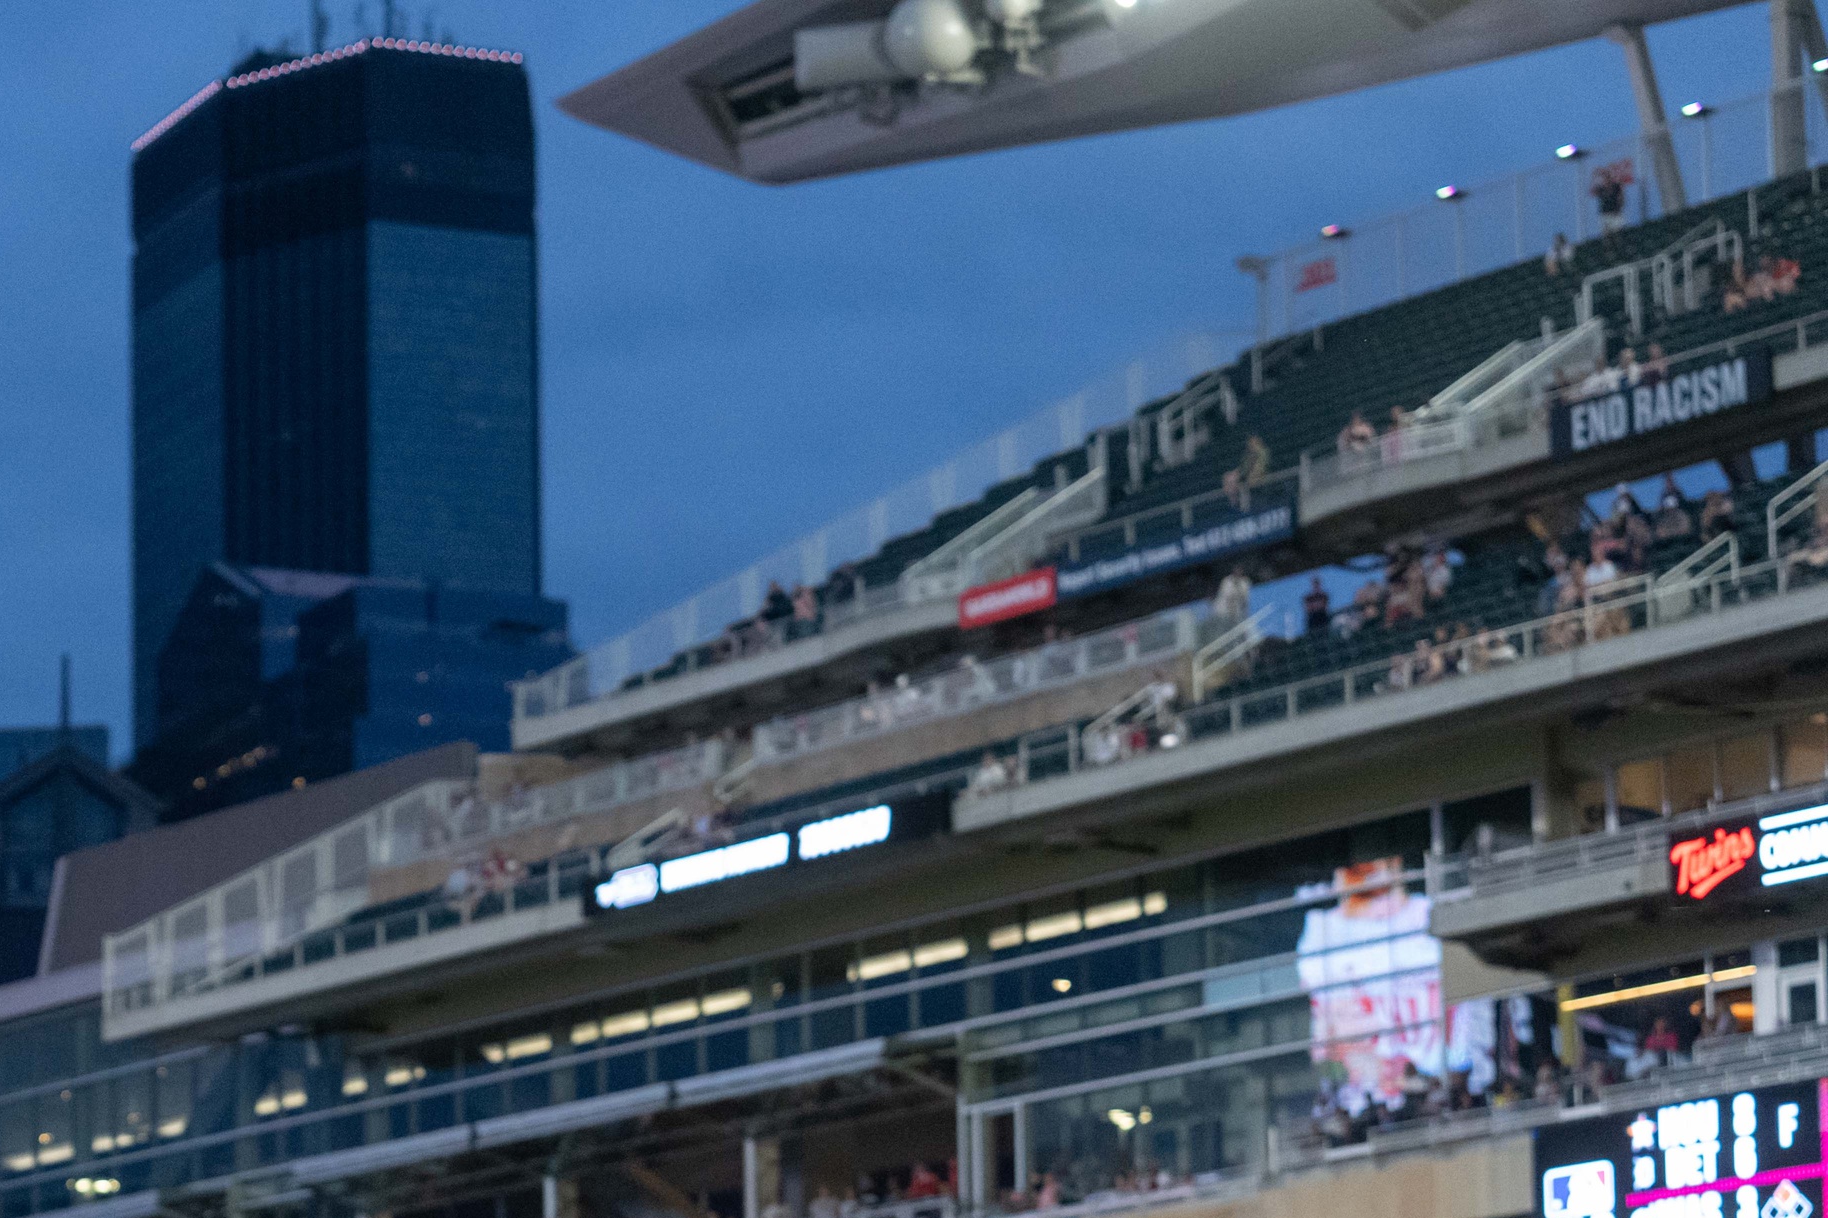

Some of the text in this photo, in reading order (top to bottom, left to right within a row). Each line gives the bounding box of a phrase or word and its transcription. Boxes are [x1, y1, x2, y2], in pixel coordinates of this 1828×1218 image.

[1571, 357, 1748, 450] END RACISM
[1670, 826, 1755, 899] Twins
